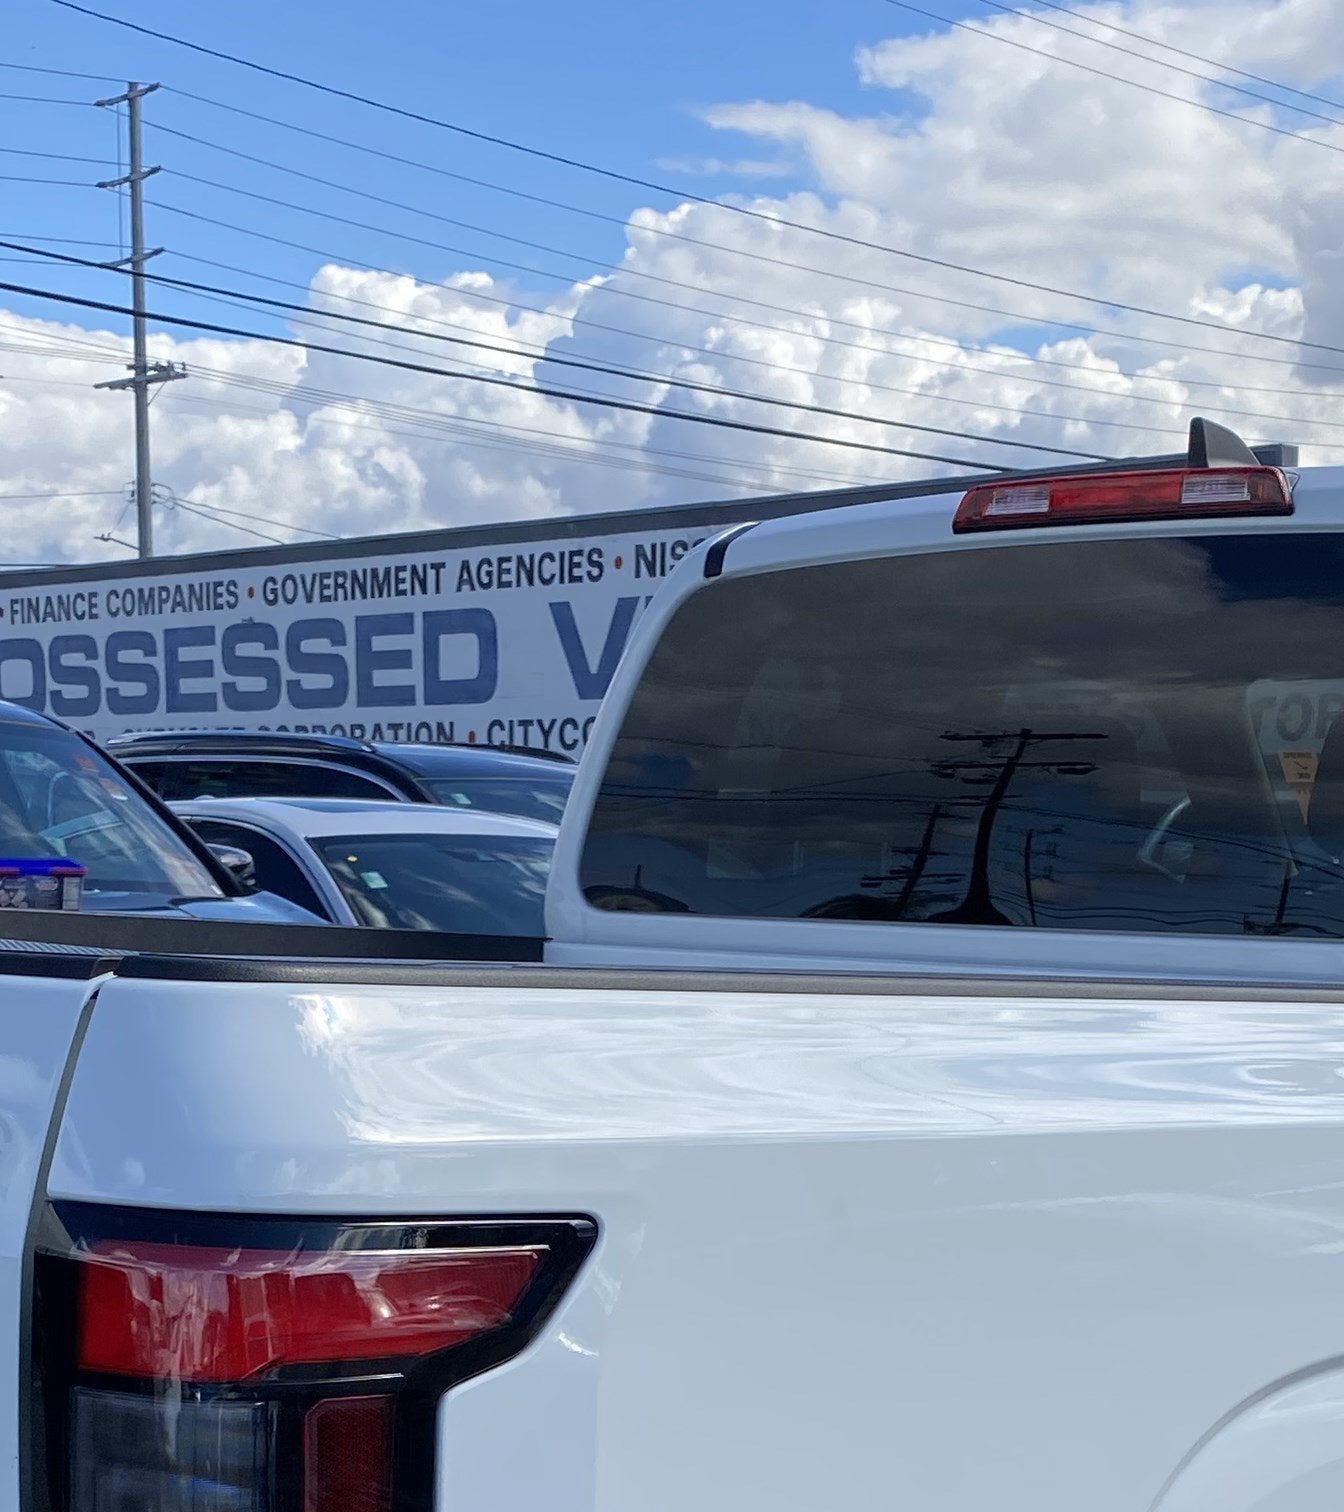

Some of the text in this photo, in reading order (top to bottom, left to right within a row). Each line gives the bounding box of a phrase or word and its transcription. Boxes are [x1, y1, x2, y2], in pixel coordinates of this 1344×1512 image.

[10, 592, 99, 625] FINANCE
[107, 580, 239, 618] COMPANIES
[263, 561, 446, 606] GOVERNMENT
[457, 547, 604, 593] AGENCIES
